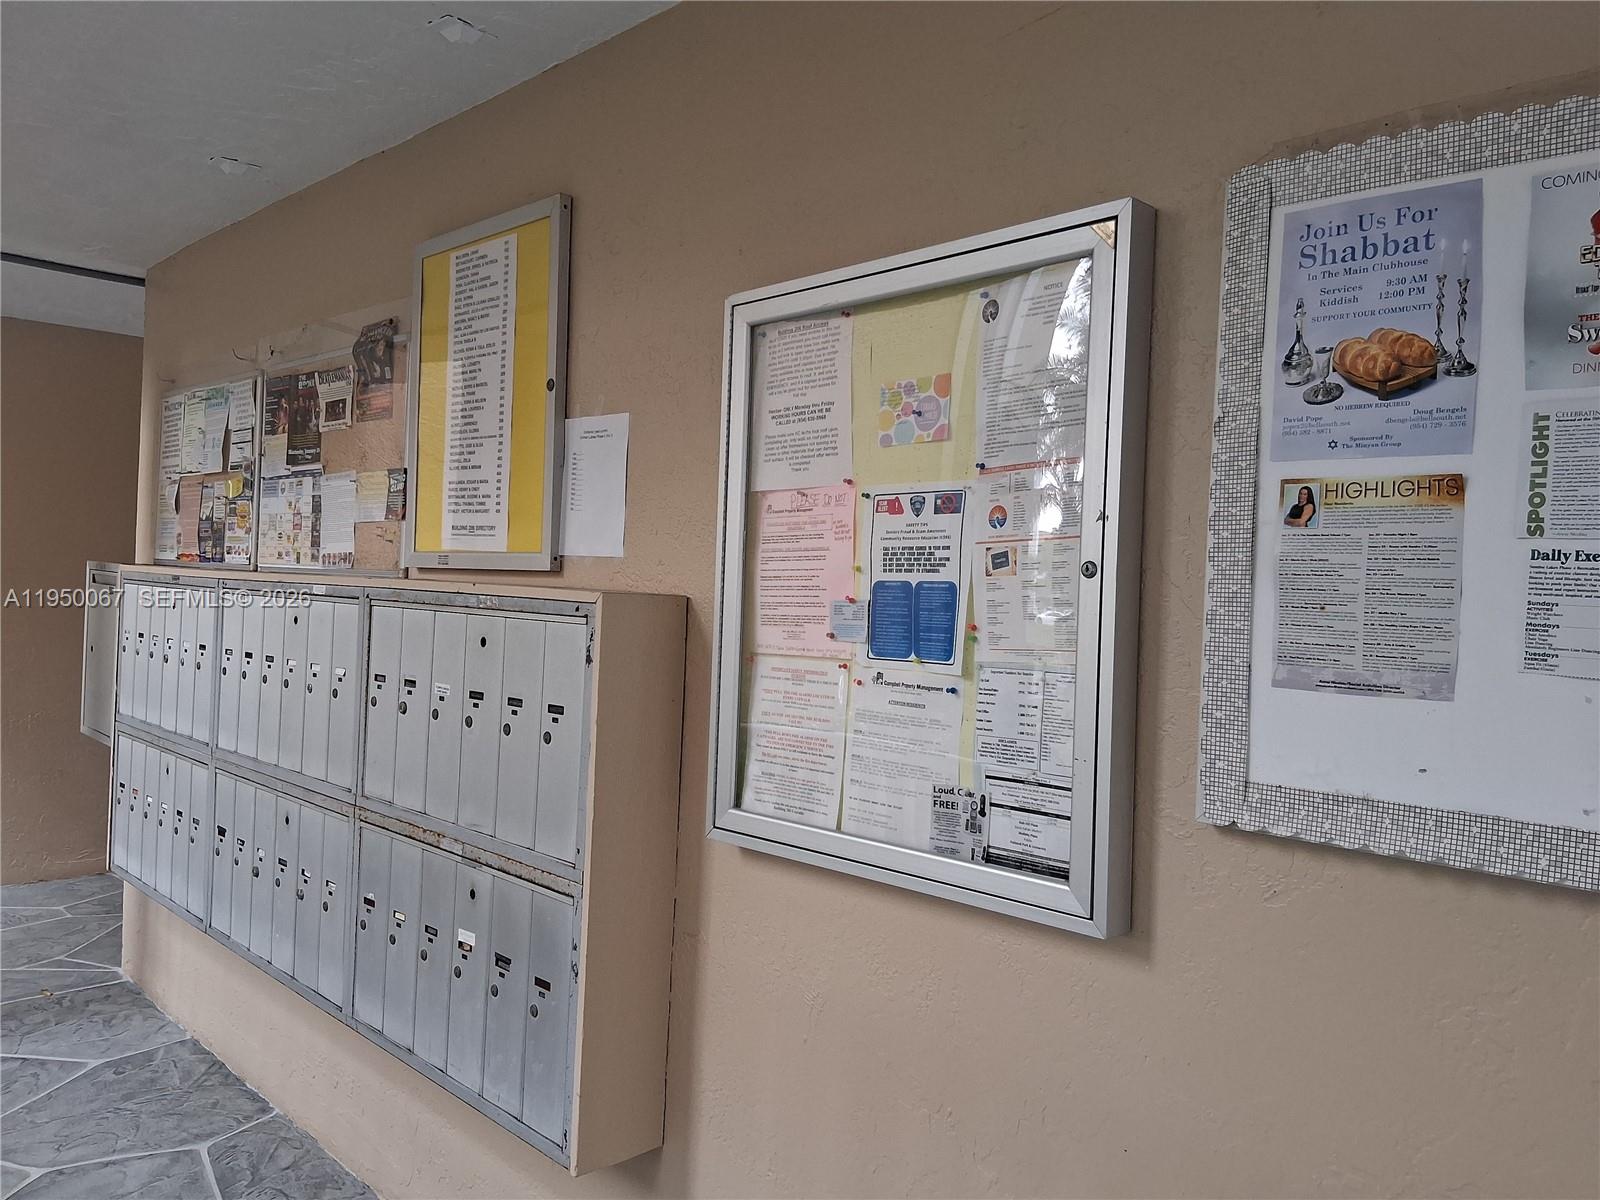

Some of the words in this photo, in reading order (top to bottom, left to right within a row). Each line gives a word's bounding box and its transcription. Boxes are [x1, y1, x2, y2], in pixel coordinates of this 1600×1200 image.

[1542, 169, 1600, 190] COMIN
[1299, 221, 1348, 242] Join
[1358, 212, 1386, 232] Us
[1395, 206, 1438, 226] For
[1298, 228, 1436, 270] Shabbat
[1320, 270, 1340, 280] The
[1343, 267, 1368, 276] Main
[1372, 258, 1428, 272] Clubhouse
[1044, 282, 1063, 290] NOTICE
[1320, 285, 1363, 296] Services
[1386, 276, 1406, 287] 9:30
[1409, 274, 1428, 284] AM
[1320, 296, 1359, 308] Kiddish
[1379, 289, 1404, 300] 12:00
[1408, 286, 1426, 296] PM
[1312, 312, 1350, 323] SUPPORT
[1353, 310, 1376, 318] YOUR
[1378, 302, 1434, 316] COMMUNITY
[1578, 313, 1600, 322] THE
[1568, 323, 1600, 344] Sw
[1572, 362, 1600, 374] DIN
[1526, 412, 1550, 538] SPOTLIGHT
[1324, 478, 1459, 499] HIGHLIGHTS
[1530, 549, 1572, 565] Daily
[916, 684, 944, 692] Management
[933, 800, 959, 811] FREE!
